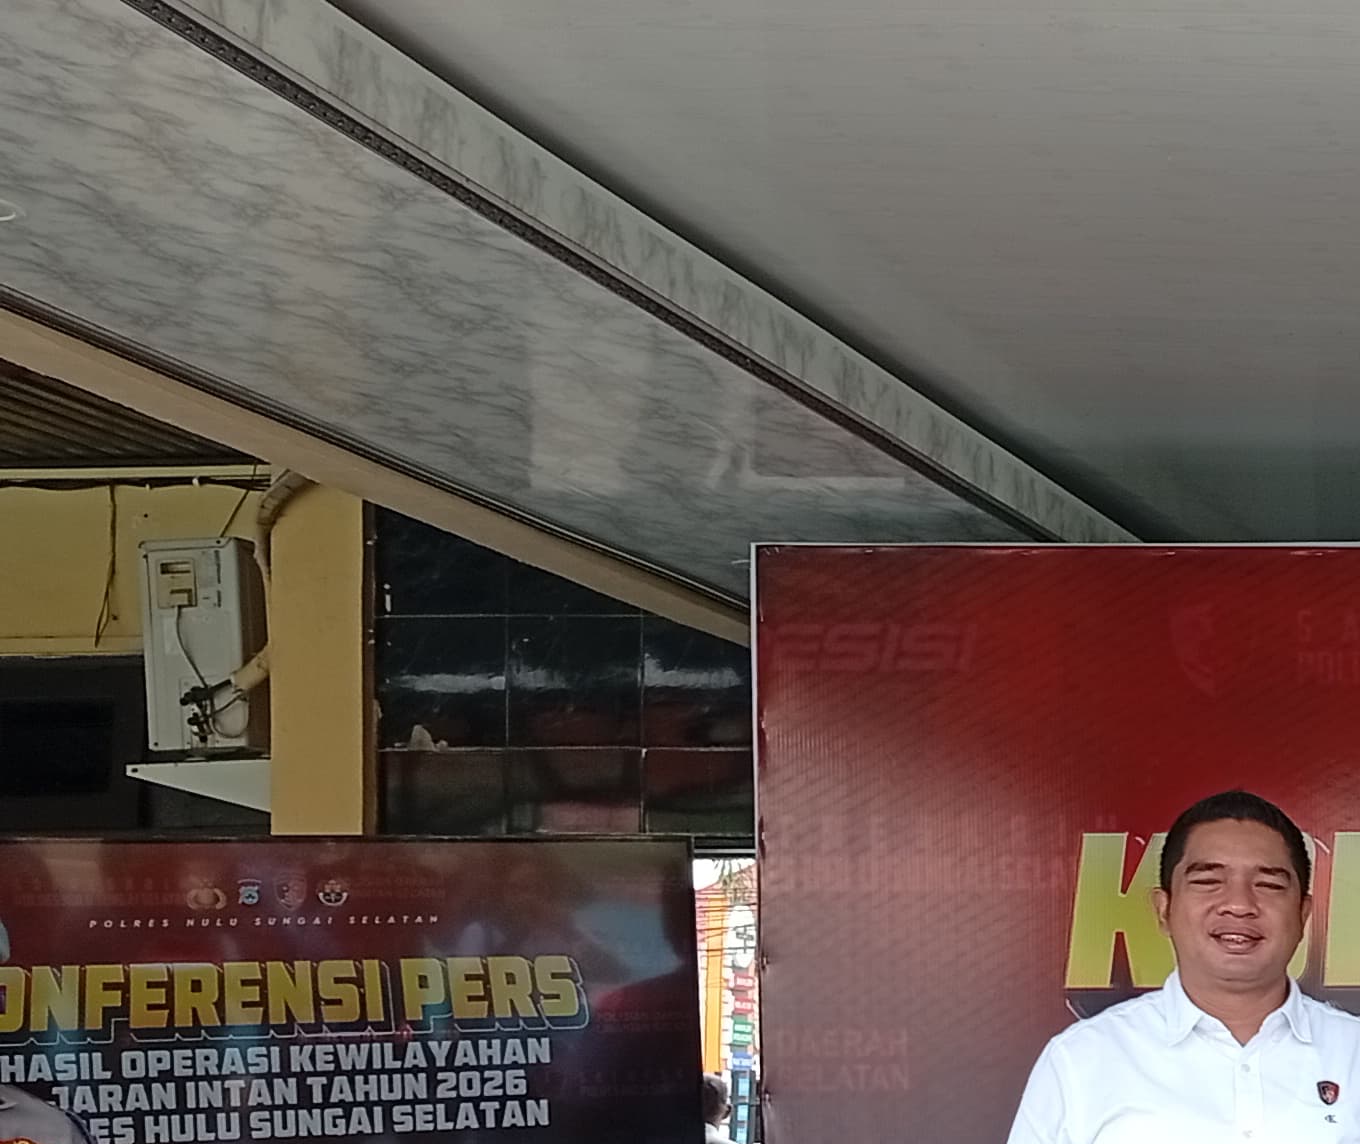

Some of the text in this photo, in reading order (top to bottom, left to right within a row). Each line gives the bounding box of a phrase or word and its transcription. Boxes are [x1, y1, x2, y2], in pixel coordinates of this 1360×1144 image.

[768, 623, 977, 672] ESISI
[89, 914, 440, 929] POLRES HULU SUNGAI SELATAN
[400, 955, 581, 1022] PERS
[1, 1037, 552, 1083] HASIL OPERASI KEWILAYAHAN
[186, 1077, 298, 1109] INTAN
[307, 1072, 427, 1103] TAHUN
[437, 1069, 528, 1100] 2026
[144, 1111, 241, 1144] HULU
[250, 1105, 384, 1141] SUNGAI
[393, 1099, 552, 1134] SELATAN
